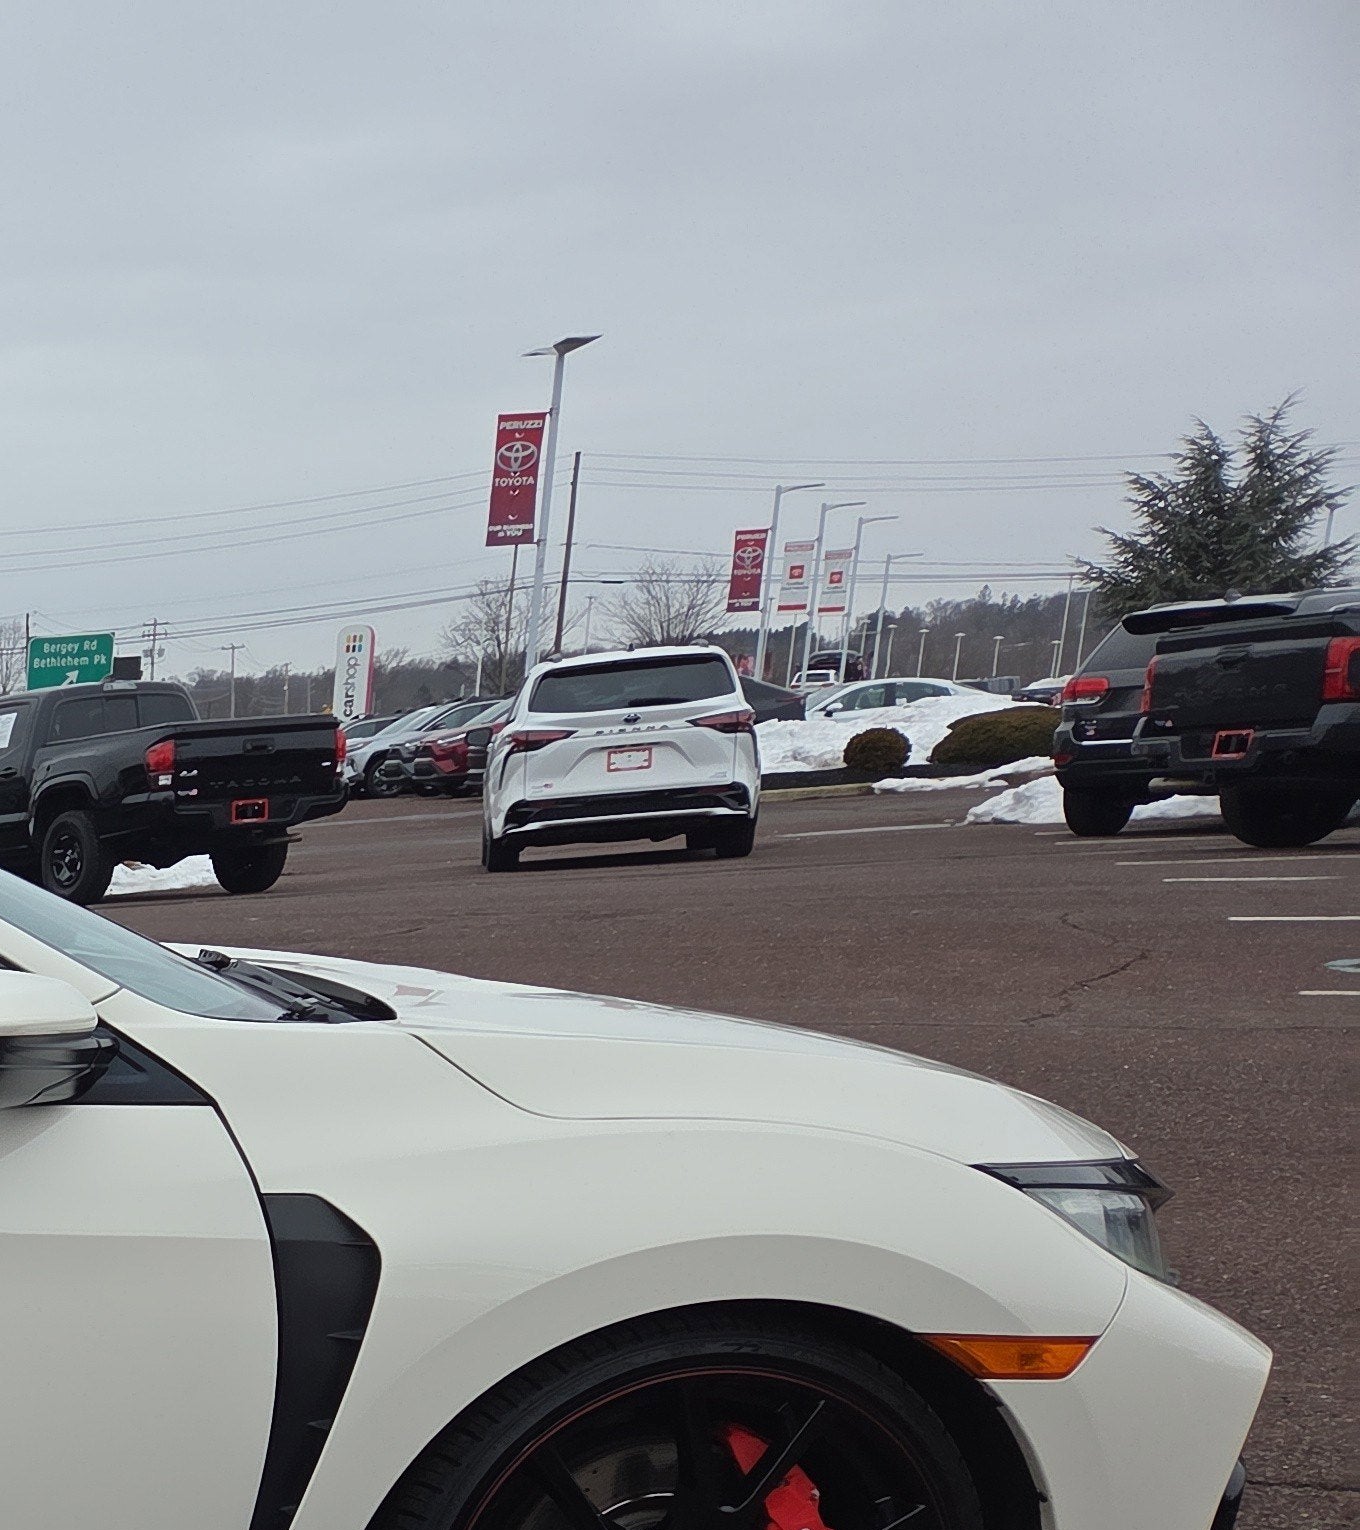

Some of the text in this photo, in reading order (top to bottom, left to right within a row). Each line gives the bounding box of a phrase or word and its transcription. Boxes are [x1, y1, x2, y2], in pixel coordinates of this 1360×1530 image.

[500, 420, 543, 430] PERUZZI
[494, 476, 535, 487] TOYOTA
[43, 640, 97, 654] Bergey Rd
[33, 653, 107, 669] Bethlehem Pk
[343, 656, 360, 717] carshop
